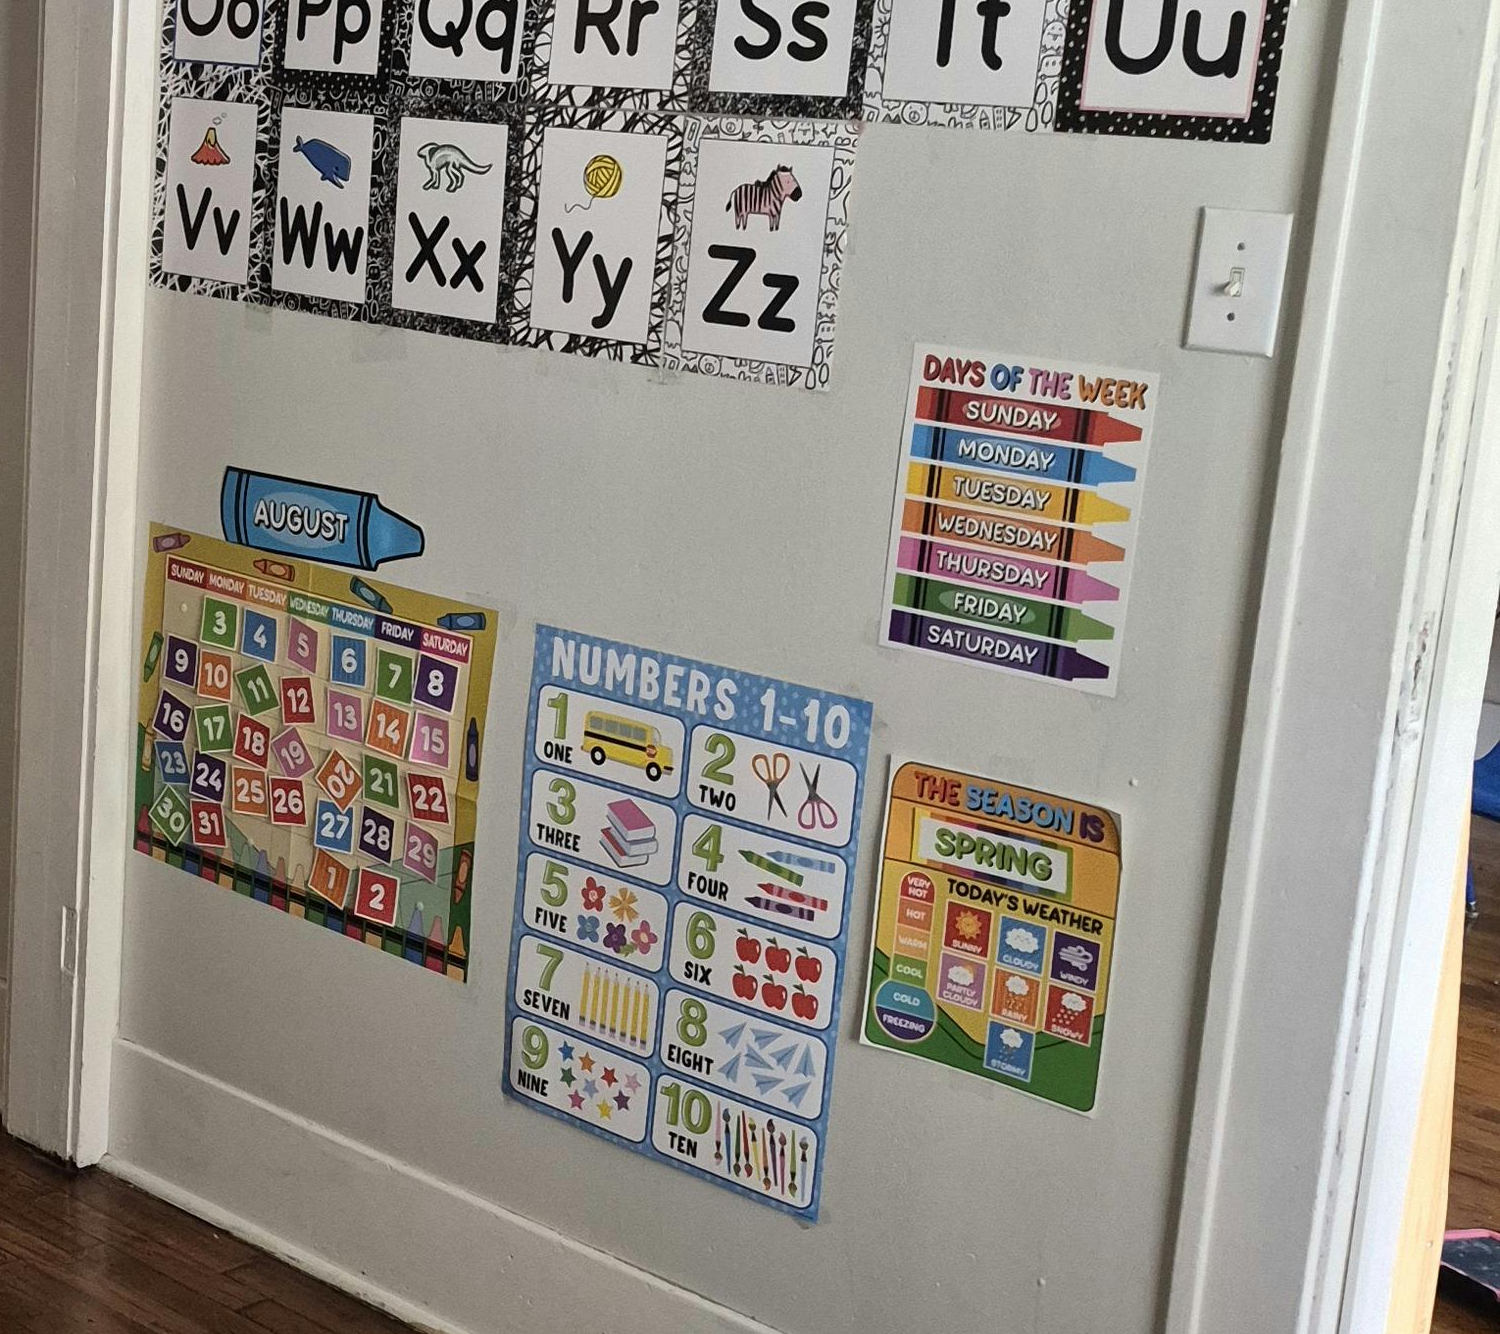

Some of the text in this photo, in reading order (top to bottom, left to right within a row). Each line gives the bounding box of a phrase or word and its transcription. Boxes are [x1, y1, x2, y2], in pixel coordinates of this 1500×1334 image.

[177, 183, 241, 256] Vv
[280, 196, 363, 274] Ww
[405, 212, 485, 292] Xx
[551, 226, 632, 328] Yy
[702, 244, 799, 332] Zz
[923, 354, 1148, 410] DAYS OF THE WEEK
[966, 401, 1057, 431] SUNDAY
[958, 439, 1055, 472] MONDAY
[953, 477, 1050, 510] TUESDAY
[254, 499, 349, 542] AUGUST
[937, 513, 1058, 553] WEDNESDAY
[936, 550, 1049, 590] THURSDAY
[171, 563, 469, 657] SUNDAY MONDAY TUESDAY WEDNESDAY THURSDAY FRIDAY SATURDAY
[954, 592, 1027, 624] FRIDAY
[212, 611, 227, 635] 3
[253, 624, 267, 649] 4
[297, 632, 311, 658] 5
[927, 625, 1038, 666] SATURDAY
[174, 648, 189, 673] 9
[341, 647, 357, 673] 6
[204, 662, 229, 688] 10
[247, 677, 268, 701] 11
[388, 662, 402, 689] 7
[427, 669, 444, 697] 8
[287, 687, 310, 713] 12
[551, 637, 851, 749] NUMBERS 1-10
[162, 702, 184, 732] 16
[203, 716, 225, 741] 17
[334, 702, 357, 731] 13
[376, 714, 400, 745] 14
[548, 692, 569, 740] 1
[242, 726, 265, 756] 18
[280, 740, 306, 767] 19
[420, 725, 444, 755] 15
[543, 741, 573, 765] ONE
[161, 750, 187, 775] 23
[701, 733, 736, 786] 2
[196, 764, 223, 793] 24
[236, 777, 265, 804] 25
[327, 758, 355, 798] 20
[370, 767, 393, 795] 21
[273, 787, 303, 815] 26
[412, 784, 445, 812] 22
[546, 778, 576, 825] 3
[698, 784, 736, 812] TWO
[914, 771, 1105, 843] THE SEASON IS
[157, 800, 185, 833] 30
[198, 812, 220, 836] 31
[320, 811, 350, 840] 27
[363, 819, 390, 851] 28
[536, 823, 581, 853] THREE
[692, 824, 724, 872] 4
[408, 835, 435, 868] 29
[934, 828, 1052, 882] SPRING
[328, 866, 336, 889] 1
[540, 860, 569, 907] 5
[687, 871, 729, 902] FOUR
[908, 876, 931, 889] VERY
[370, 883, 385, 910] 2
[908, 886, 928, 899] HOT
[947, 877, 1104, 936] TODAY'S WEATHER
[535, 906, 567, 934] FIVE
[906, 908, 926, 920] HOT
[685, 911, 717, 960] 6
[899, 935, 927, 950] WARM
[952, 939, 983, 955] SUNNY
[535, 943, 565, 991] 7
[683, 960, 712, 986] SIX
[896, 964, 924, 979] COOL
[1002, 954, 1039, 971] CLOUDY
[946, 983, 976, 998] PARTLY
[1059, 970, 1089, 986] WINDY
[523, 988, 571, 1020] SEVEN
[893, 991, 921, 1007] COLD
[942, 990, 979, 1007] CLOUDY
[676, 997, 708, 1047] 8
[882, 1013, 926, 1033] FREEZING
[1001, 1008, 1028, 1023] RAINY
[521, 1024, 549, 1070] 9
[1051, 1024, 1084, 1041] SNOWY
[667, 1043, 714, 1077] EIGHT
[990, 1058, 1026, 1077] STORMY
[517, 1069, 549, 1097] NINE
[660, 1081, 712, 1135] 10
[668, 1131, 698, 1159] TEN
